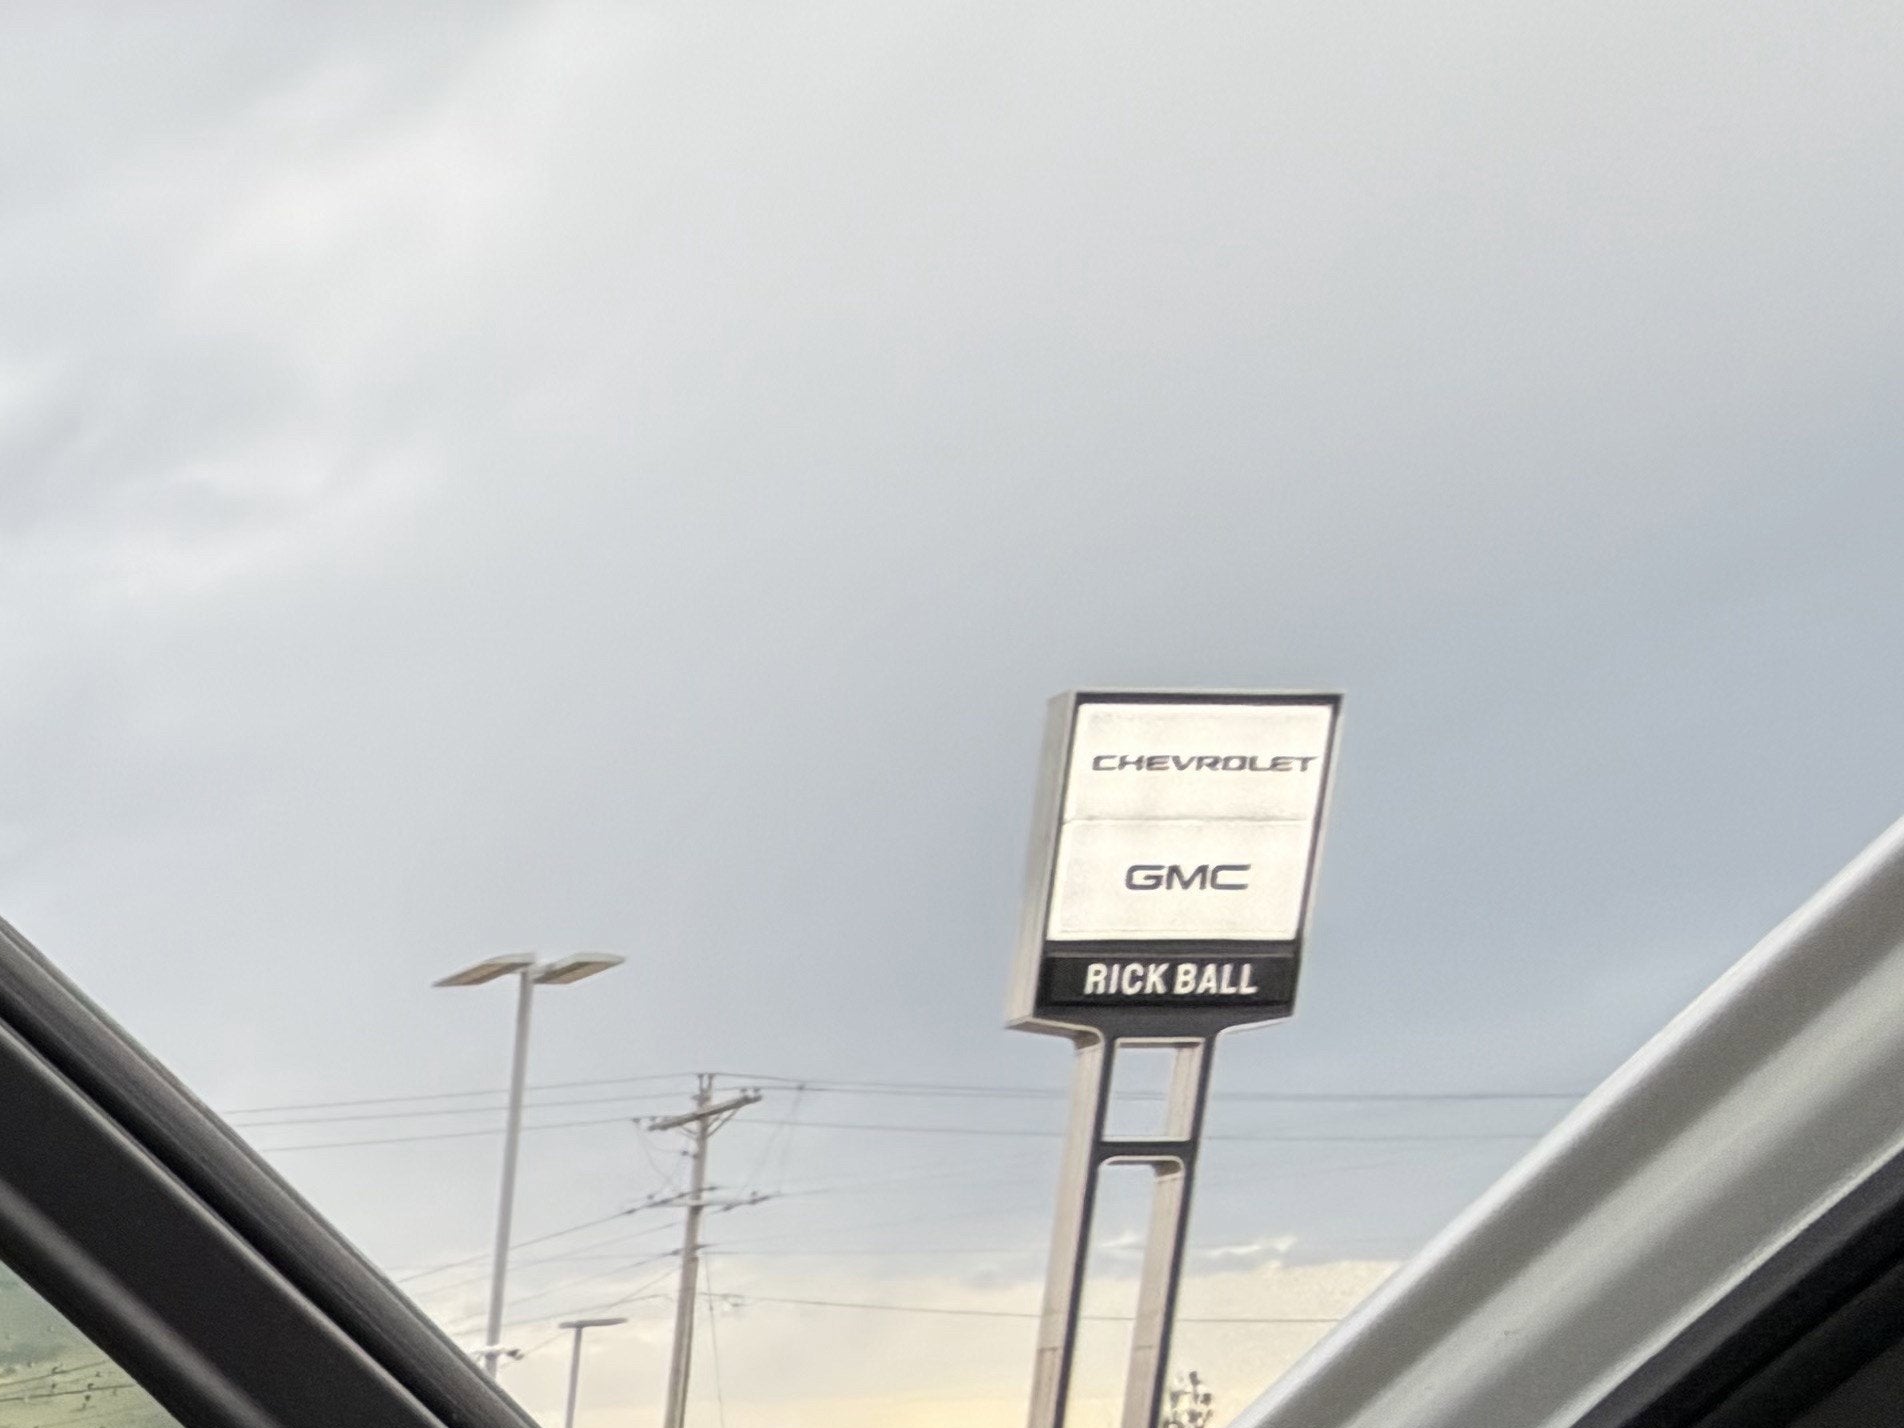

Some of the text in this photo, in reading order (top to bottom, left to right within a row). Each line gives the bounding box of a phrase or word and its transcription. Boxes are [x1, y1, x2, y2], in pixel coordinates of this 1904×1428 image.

[1091, 754, 1318, 772] CHEVROLET
[1124, 863, 1252, 891] GMC
[1083, 962, 1259, 996] RICK BALL
